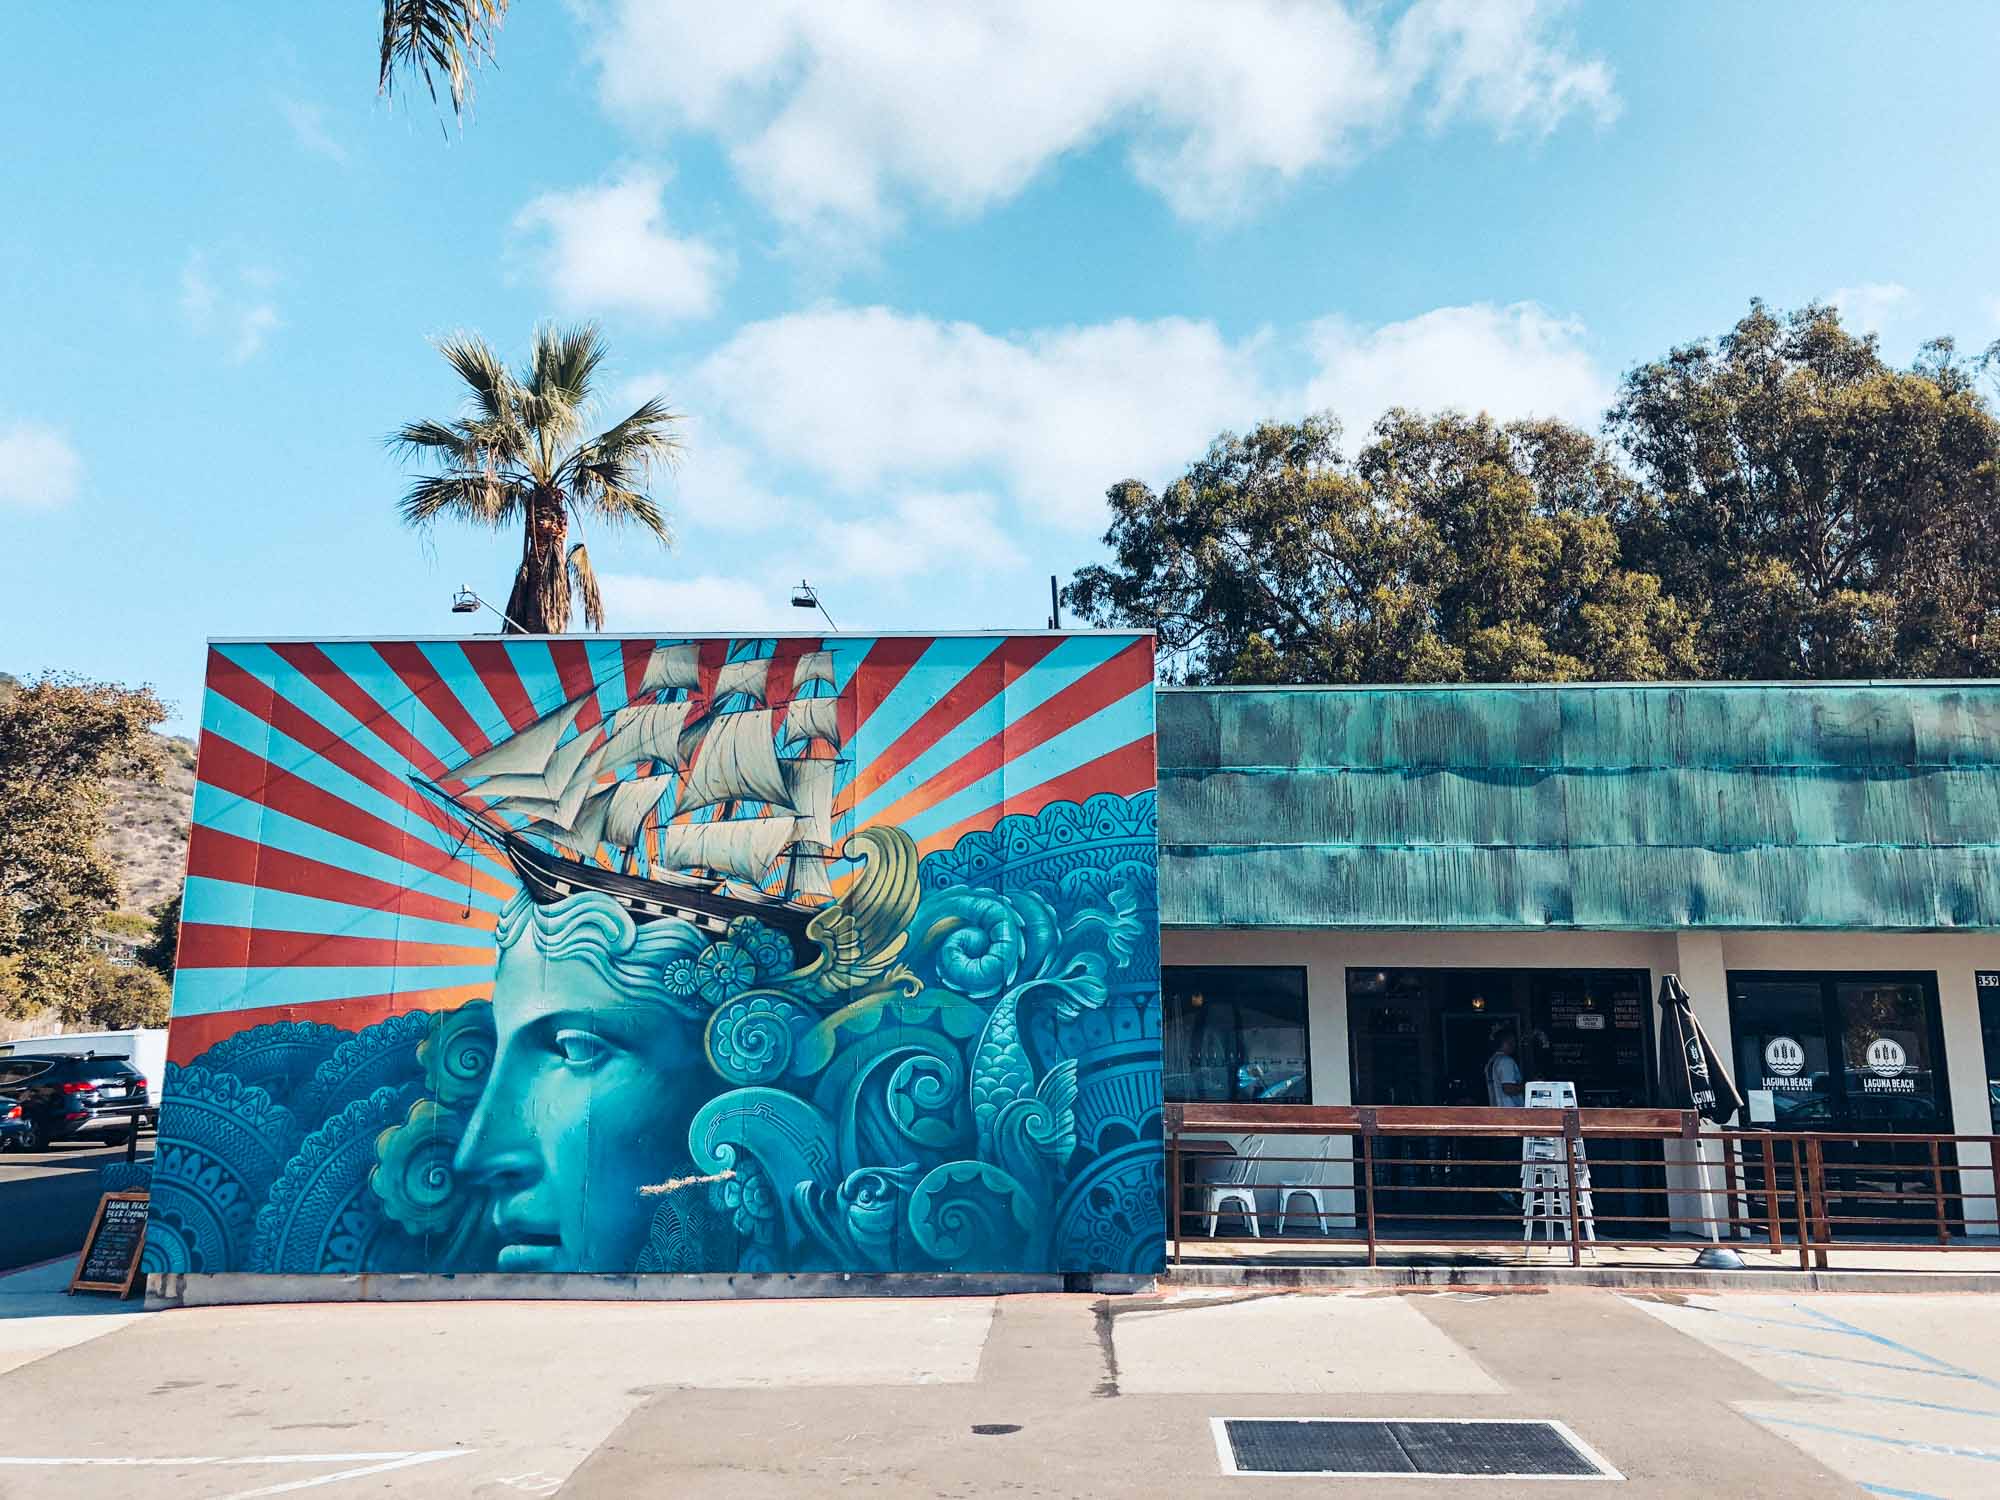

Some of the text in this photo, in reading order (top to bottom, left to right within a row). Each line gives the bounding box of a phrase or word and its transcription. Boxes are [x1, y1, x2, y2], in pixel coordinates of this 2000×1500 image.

[1762, 1077, 1812, 1086] LAGUNA BEACH
[1864, 1079, 1914, 1088] LAGUNA BEACH
